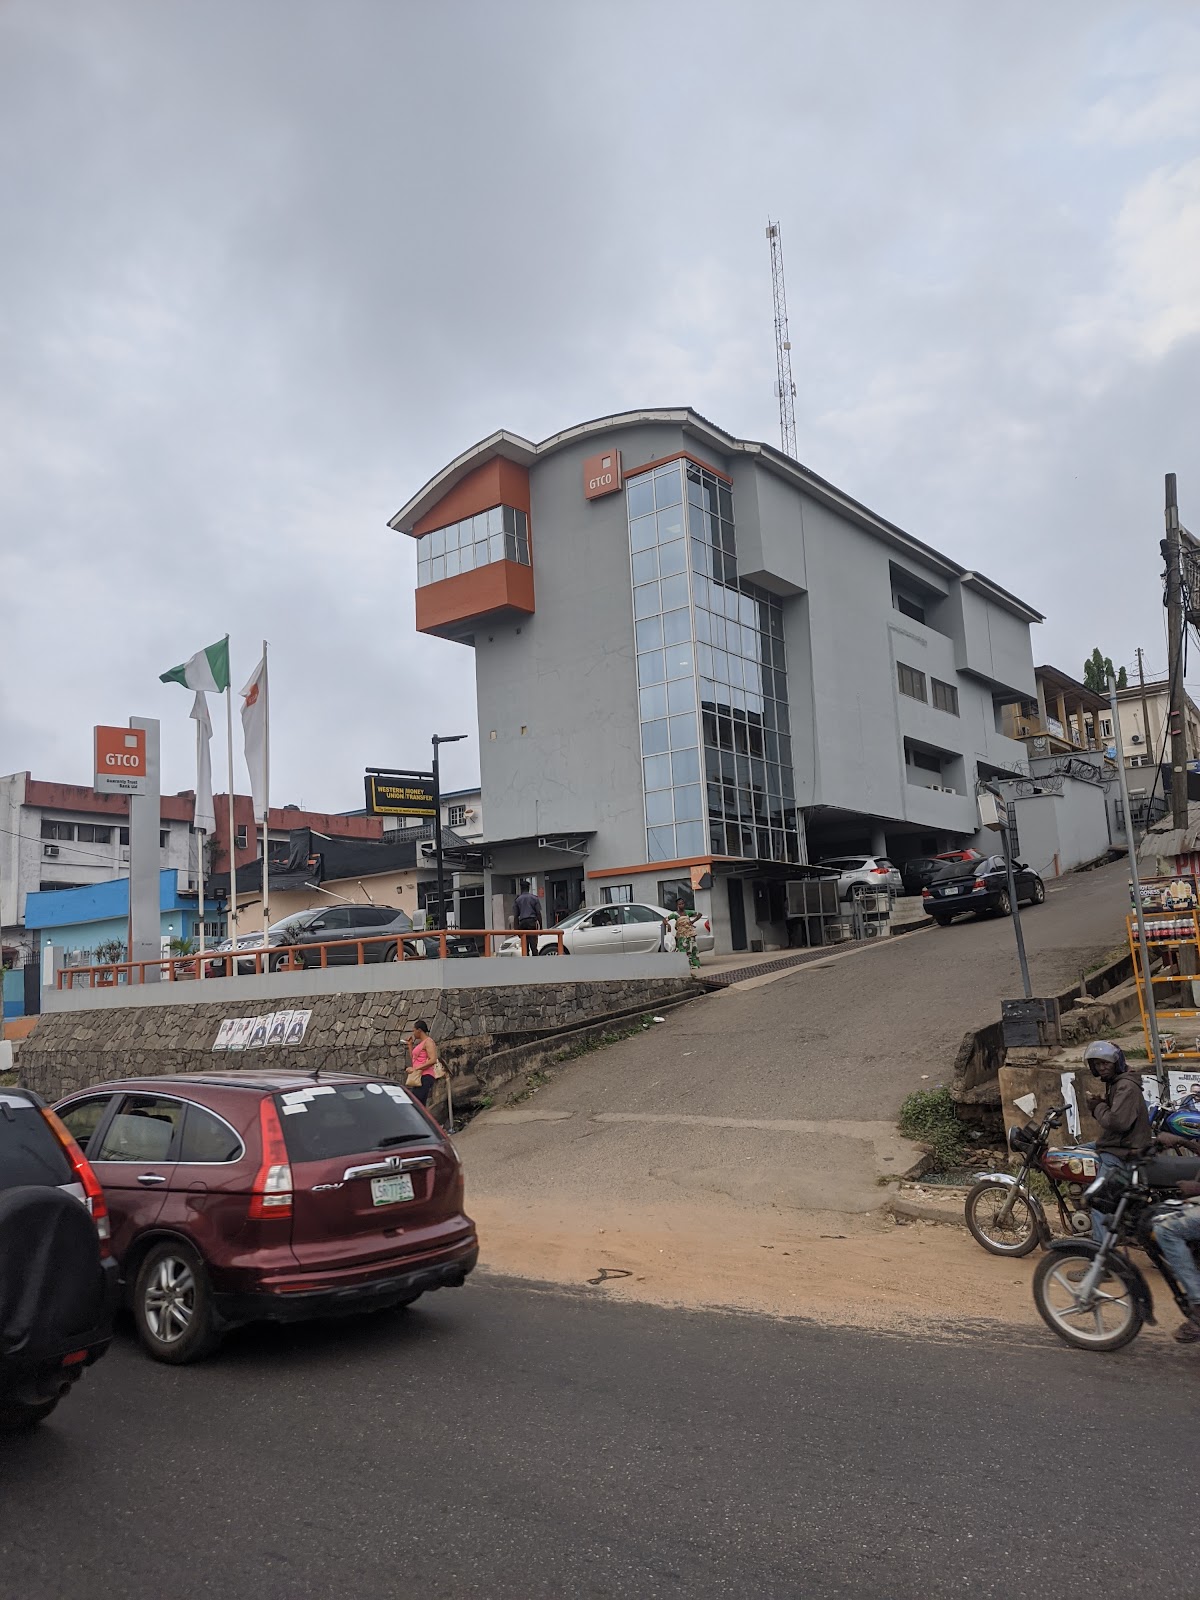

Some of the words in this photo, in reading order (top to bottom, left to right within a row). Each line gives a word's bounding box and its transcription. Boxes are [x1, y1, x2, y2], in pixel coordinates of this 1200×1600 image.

[589, 473, 612, 490] GTCO
[105, 753, 139, 767] GTCO
[377, 786, 404, 794] WESTERN
[405, 793, 433, 802] TRANSFER
